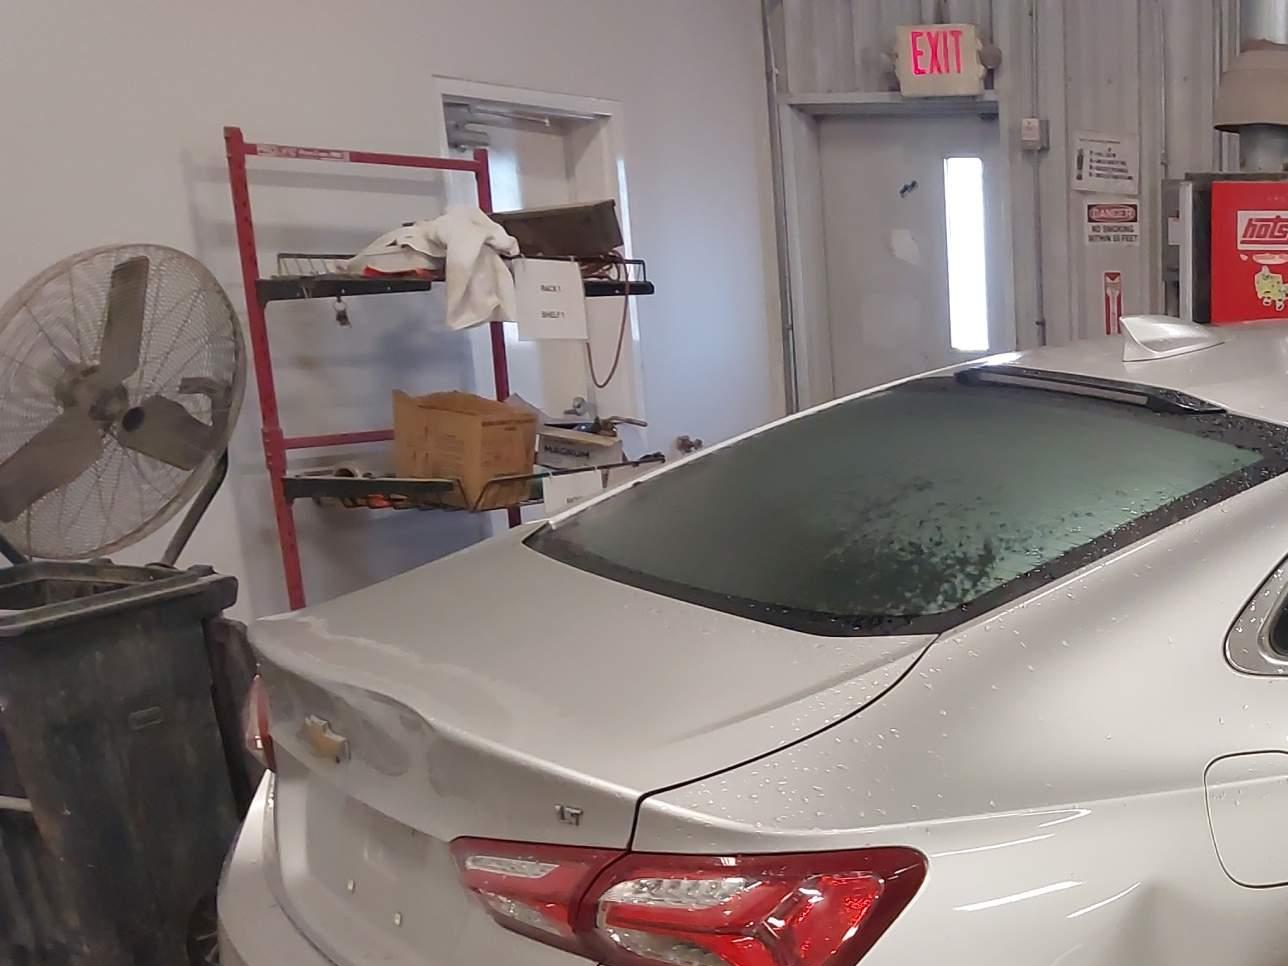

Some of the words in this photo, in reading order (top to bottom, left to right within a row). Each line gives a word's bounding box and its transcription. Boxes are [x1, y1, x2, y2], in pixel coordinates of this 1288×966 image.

[911, 31, 962, 75] EXIT
[1092, 208, 1134, 218] DANGER
[555, 804, 584, 827] LT
